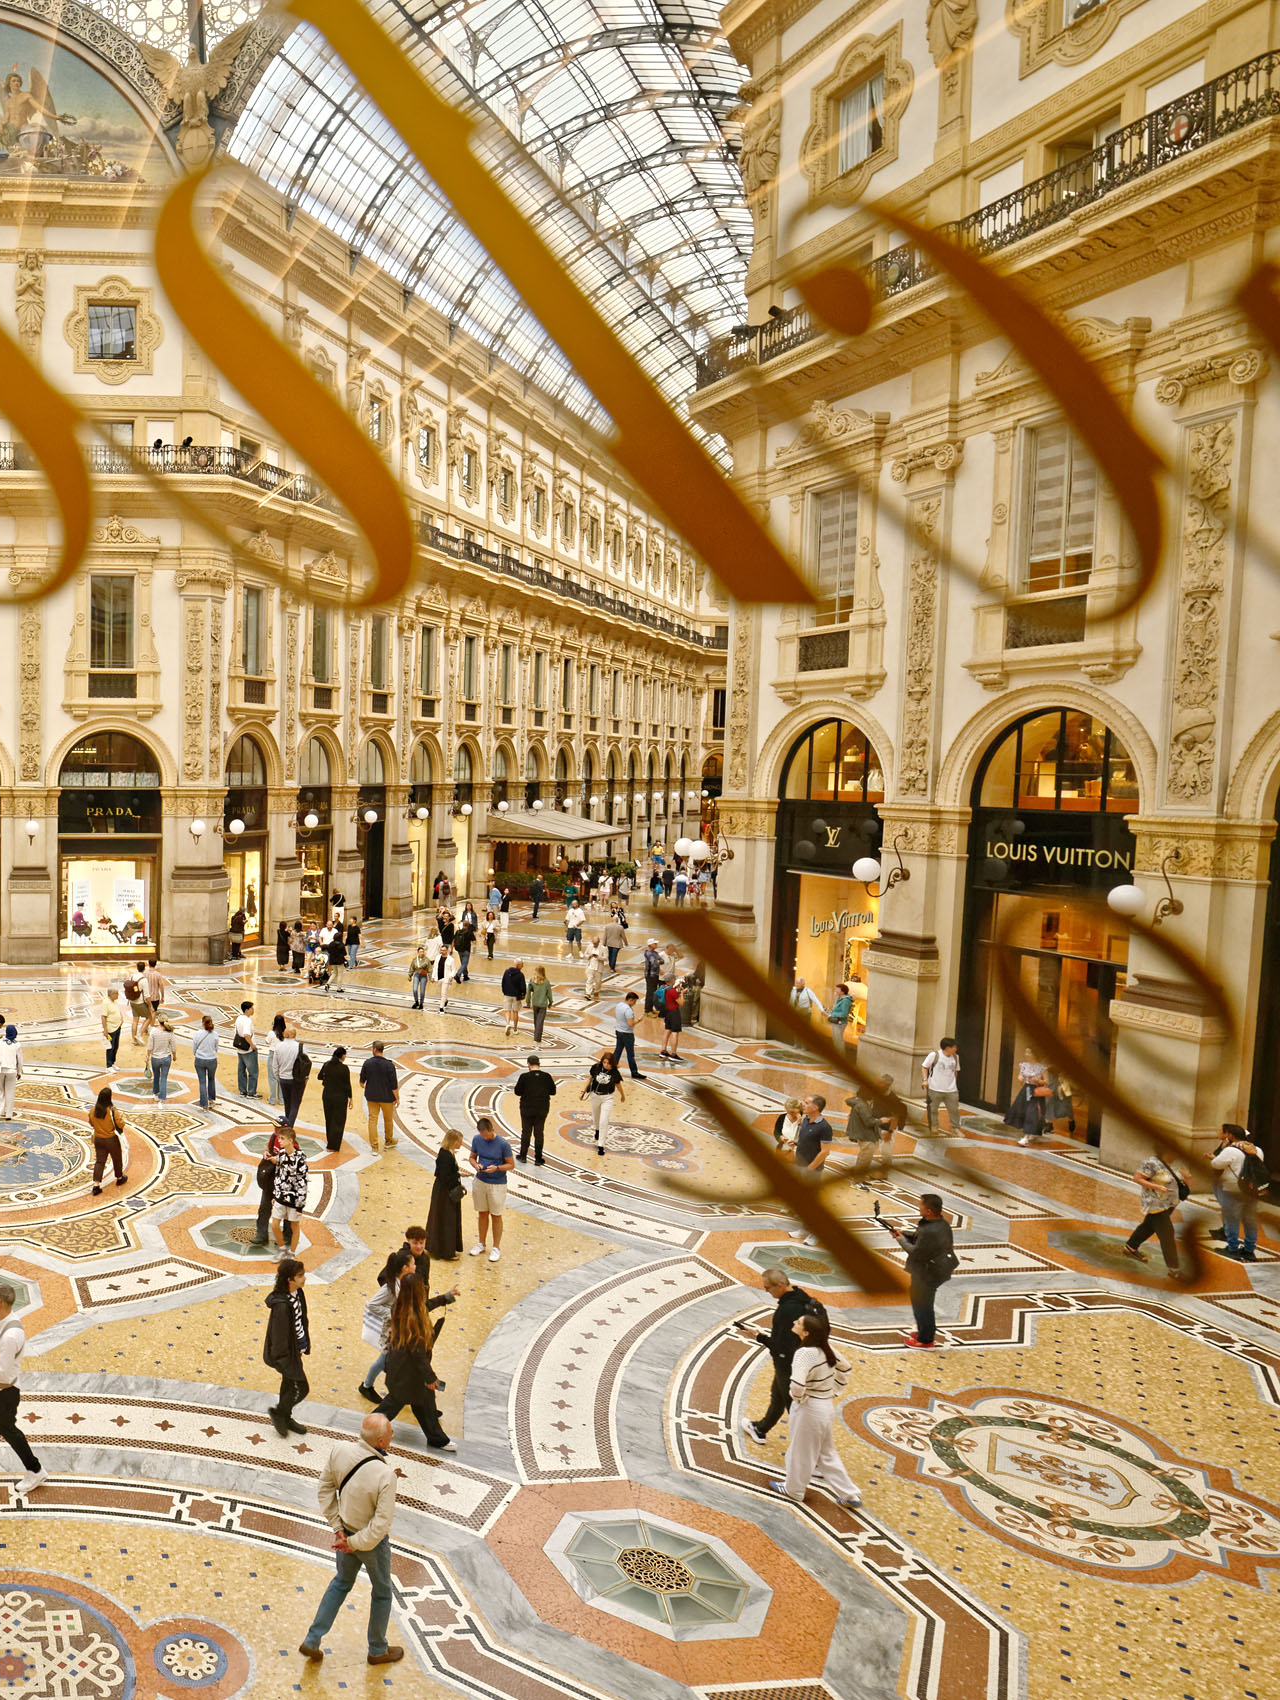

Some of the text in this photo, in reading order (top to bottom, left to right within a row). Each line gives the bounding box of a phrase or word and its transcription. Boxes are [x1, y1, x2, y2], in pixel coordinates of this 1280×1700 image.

[86, 807, 134, 817] PRADA
[231, 805, 256, 815] PRADA
[986, 841, 1131, 871] LOUIS VUITTON
